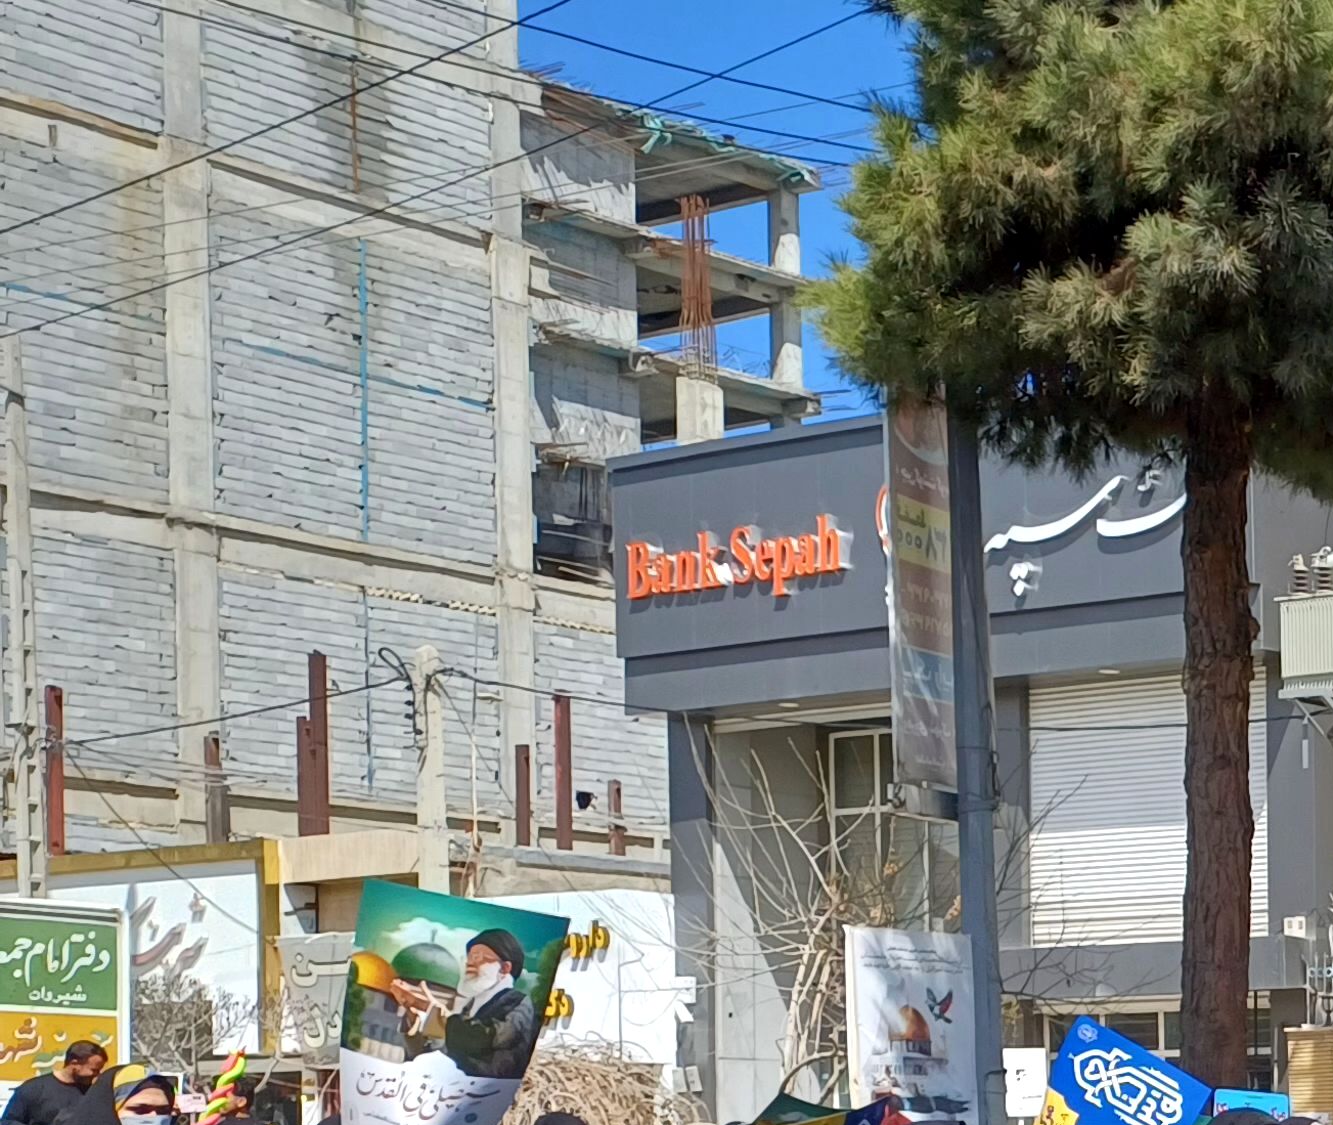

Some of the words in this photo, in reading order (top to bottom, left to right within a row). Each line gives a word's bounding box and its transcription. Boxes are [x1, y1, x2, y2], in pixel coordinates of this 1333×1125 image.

[626, 531, 728, 600] Bank
[730, 514, 843, 596] Sepah
[24, 938, 70, 987] امام
[61, 931, 111, 984] دفتر
[29, 985, 88, 1006] شیروان
